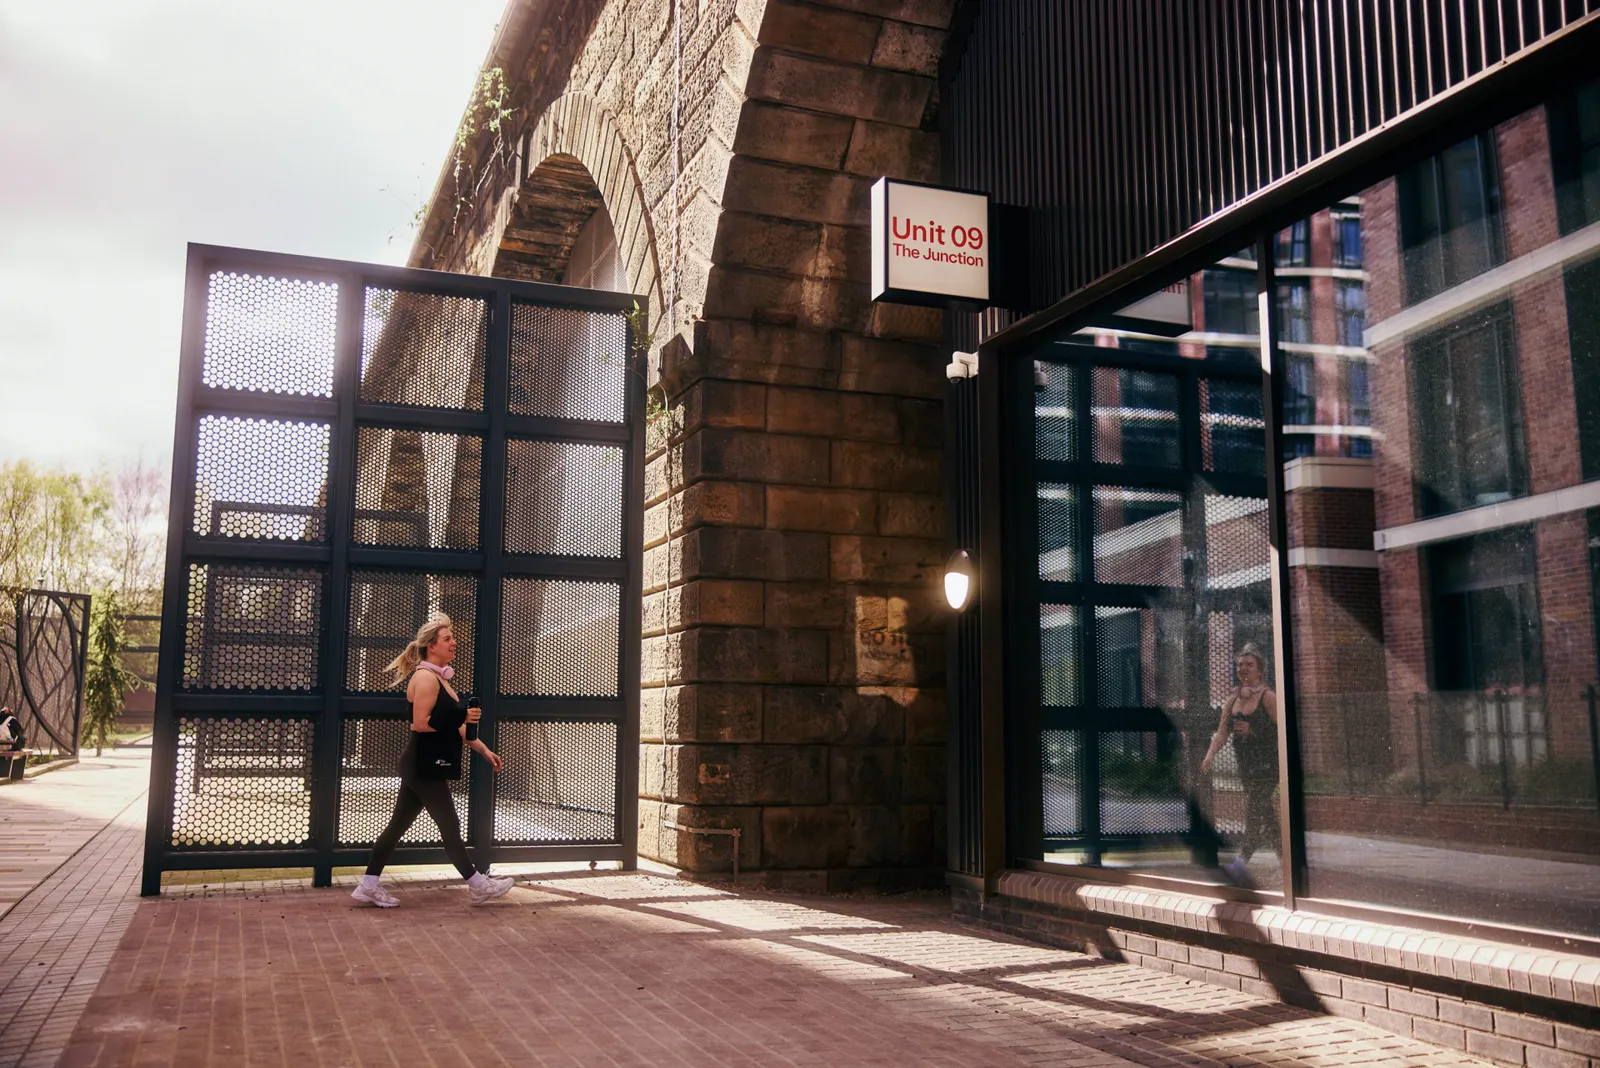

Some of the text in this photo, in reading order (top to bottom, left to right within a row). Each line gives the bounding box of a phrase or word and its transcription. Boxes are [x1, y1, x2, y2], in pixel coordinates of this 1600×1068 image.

[892, 216, 983, 250] Unit 09
[892, 243, 984, 267] The Junction
